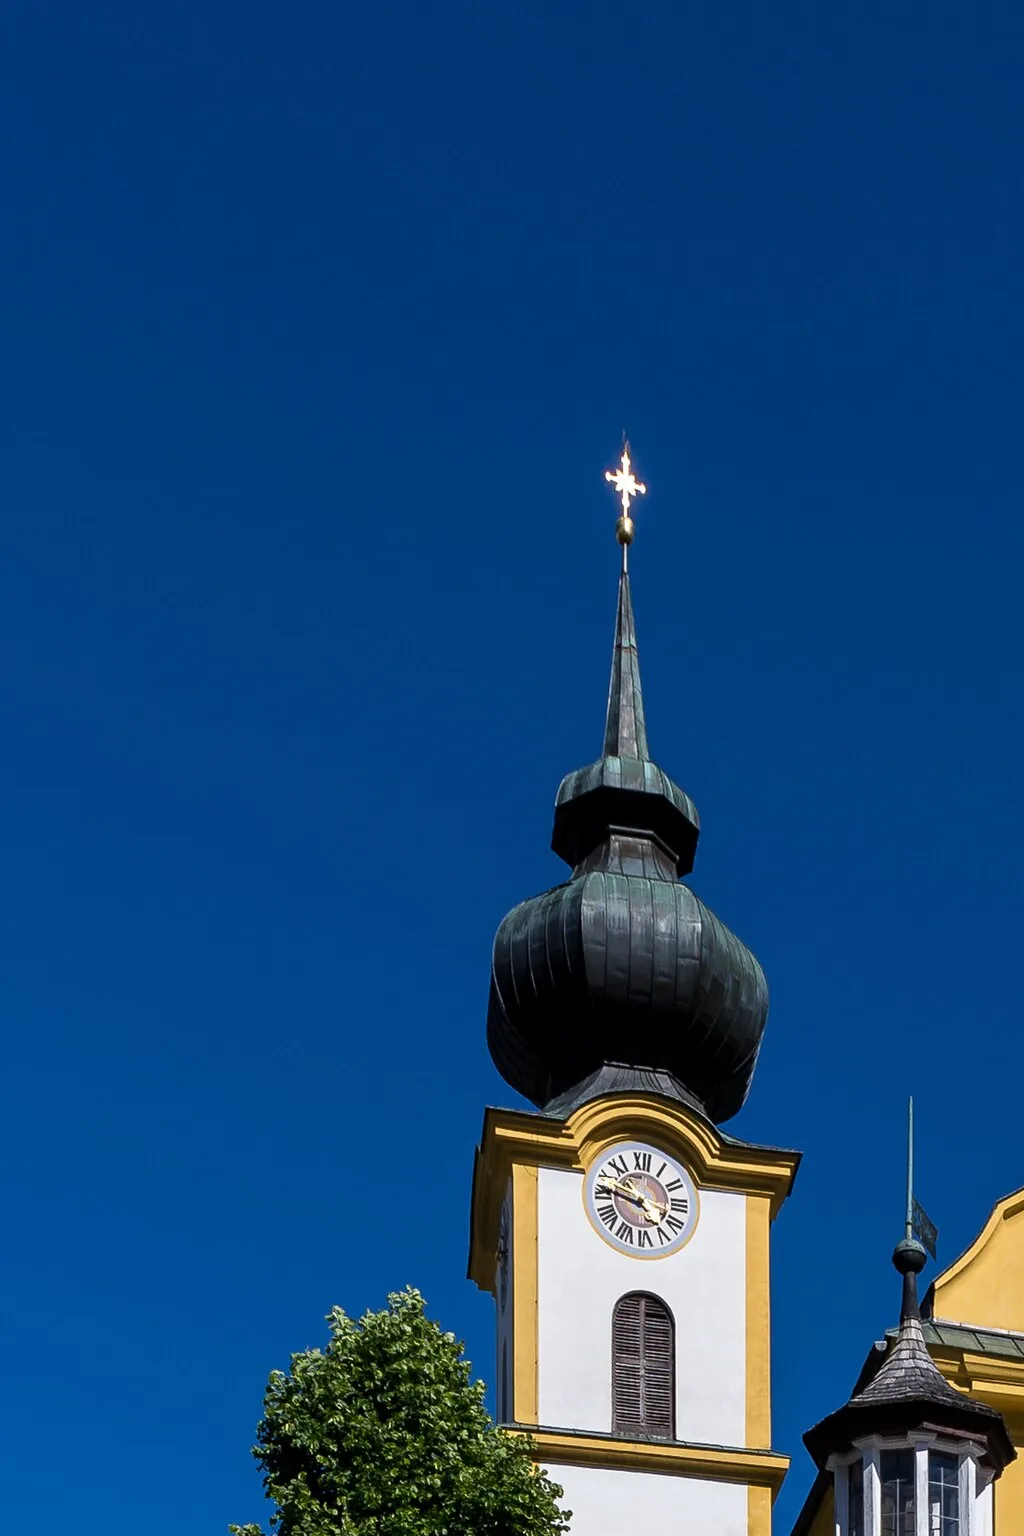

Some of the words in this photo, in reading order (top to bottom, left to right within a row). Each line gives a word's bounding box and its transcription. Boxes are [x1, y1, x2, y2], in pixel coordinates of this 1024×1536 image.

[608, 1154, 629, 1177] XI
[633, 1152, 652, 1172] XII
[656, 1162, 667, 1178] I
[666, 1178, 684, 1192] II
[670, 1198, 688, 1214] III
[597, 1204, 618, 1232] VIII
[666, 1214, 684, 1235] IV
[614, 1222, 634, 1244] VII
[638, 1230, 654, 1248] VI
[656, 1227, 671, 1245] V
